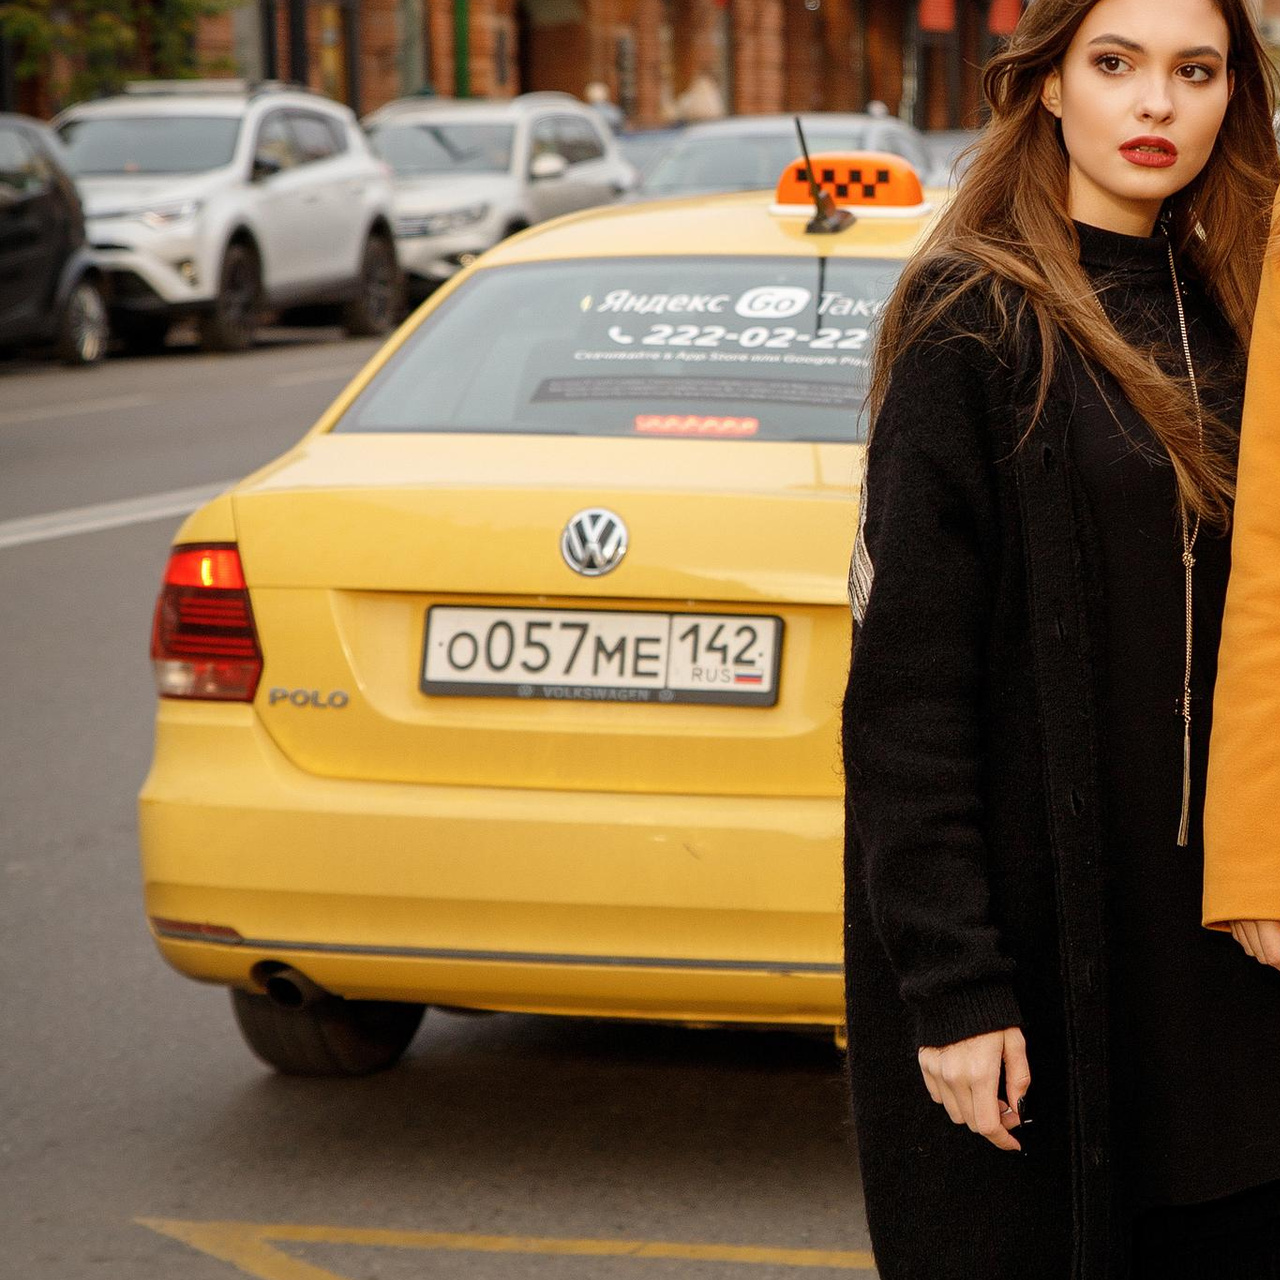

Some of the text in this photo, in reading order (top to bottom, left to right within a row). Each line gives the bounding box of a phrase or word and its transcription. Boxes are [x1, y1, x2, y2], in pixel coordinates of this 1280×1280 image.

[597, 289, 730, 314] Яндекс
[641, 324, 868, 349] 222-02-22
[674, 351, 706, 363] App
[709, 352, 748, 362] Store
[750, 353, 779, 363] или
[783, 353, 836, 366] Google
[680, 623, 758, 667] 142
[691, 667, 731, 683] RUS
[269, 686, 349, 709] POLO
[543, 686, 649, 702] VOLKSWAGEN
